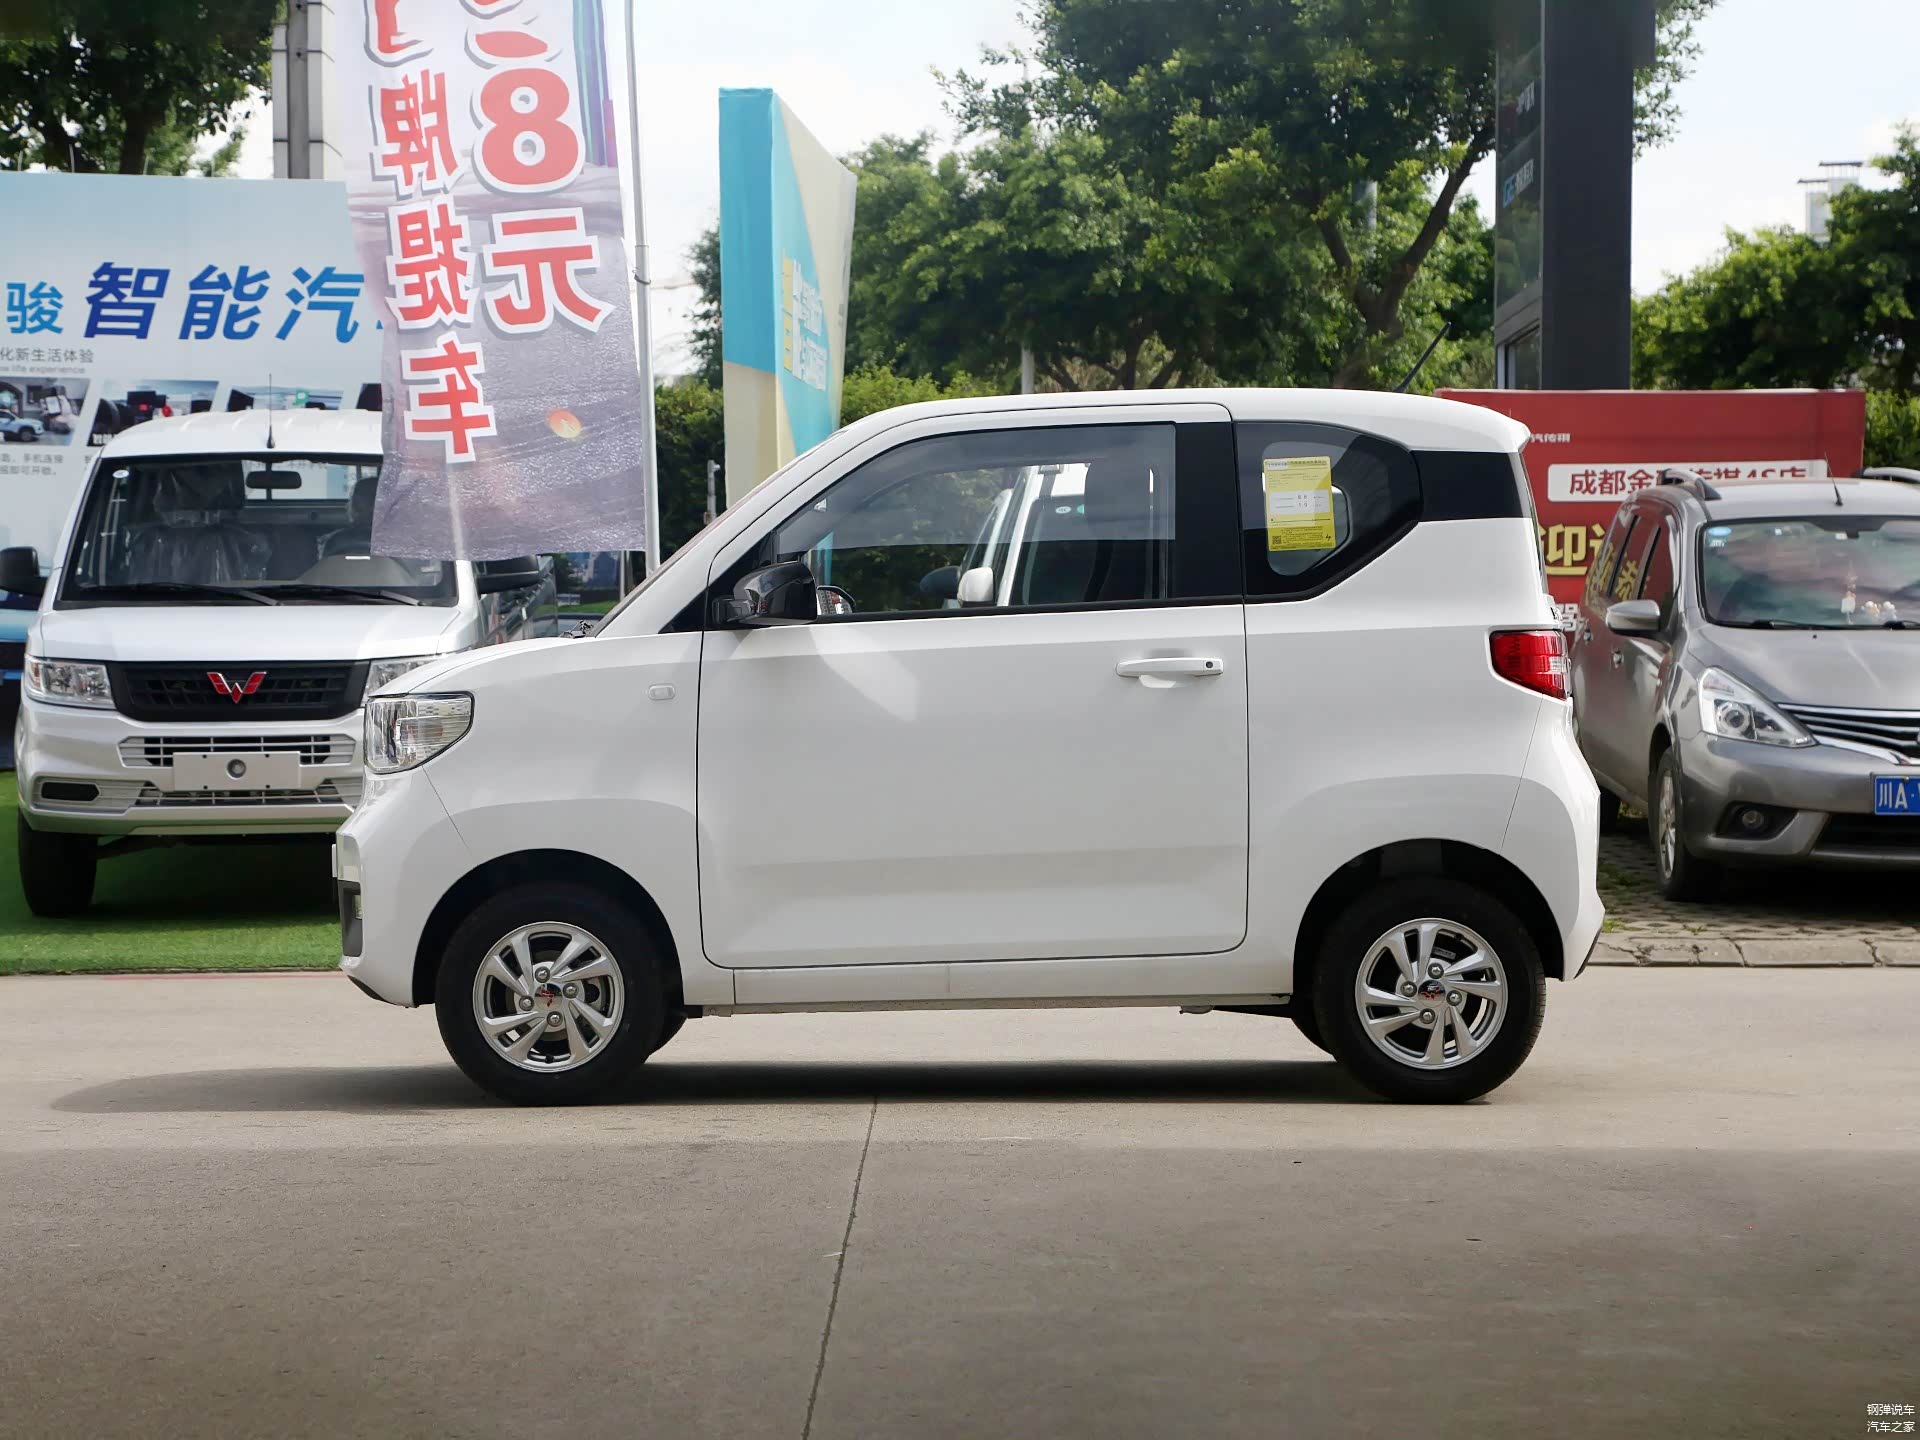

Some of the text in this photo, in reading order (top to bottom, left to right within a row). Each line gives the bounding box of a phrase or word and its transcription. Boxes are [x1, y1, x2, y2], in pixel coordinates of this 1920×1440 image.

[6, 261, 383, 344] 骏 智能汽
